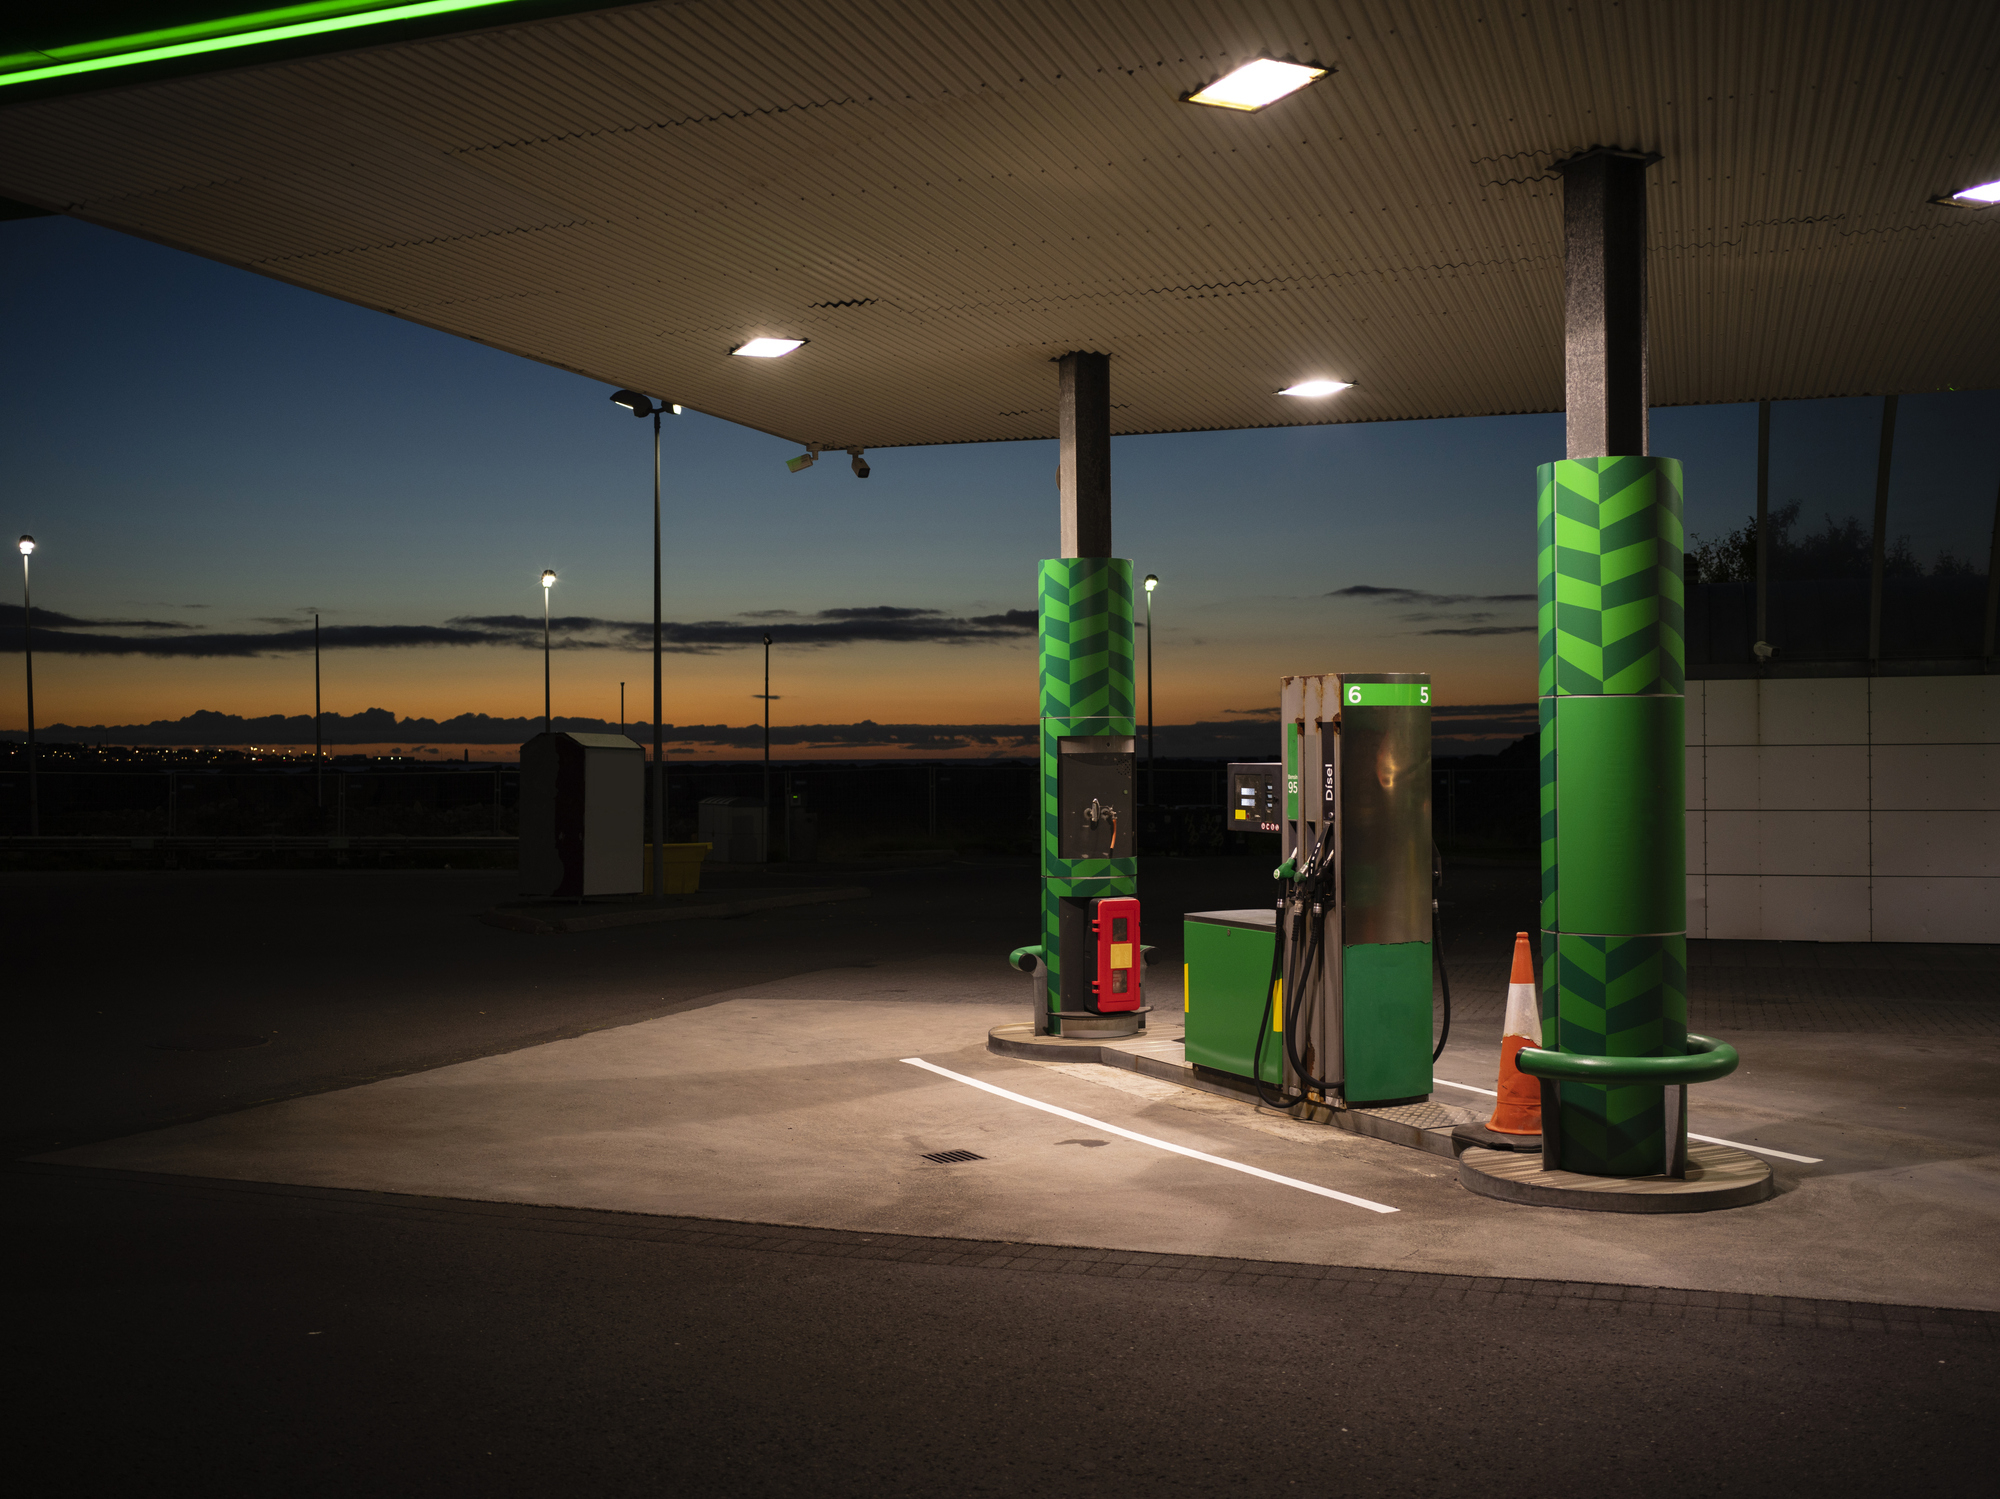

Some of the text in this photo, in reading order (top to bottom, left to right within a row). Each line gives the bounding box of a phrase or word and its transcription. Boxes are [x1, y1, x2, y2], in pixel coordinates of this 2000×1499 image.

[1348, 686, 1362, 703] 6
[1420, 686, 1429, 703] 5
[1288, 781, 1298, 794] 95
[1325, 764, 1333, 801] Dísel
